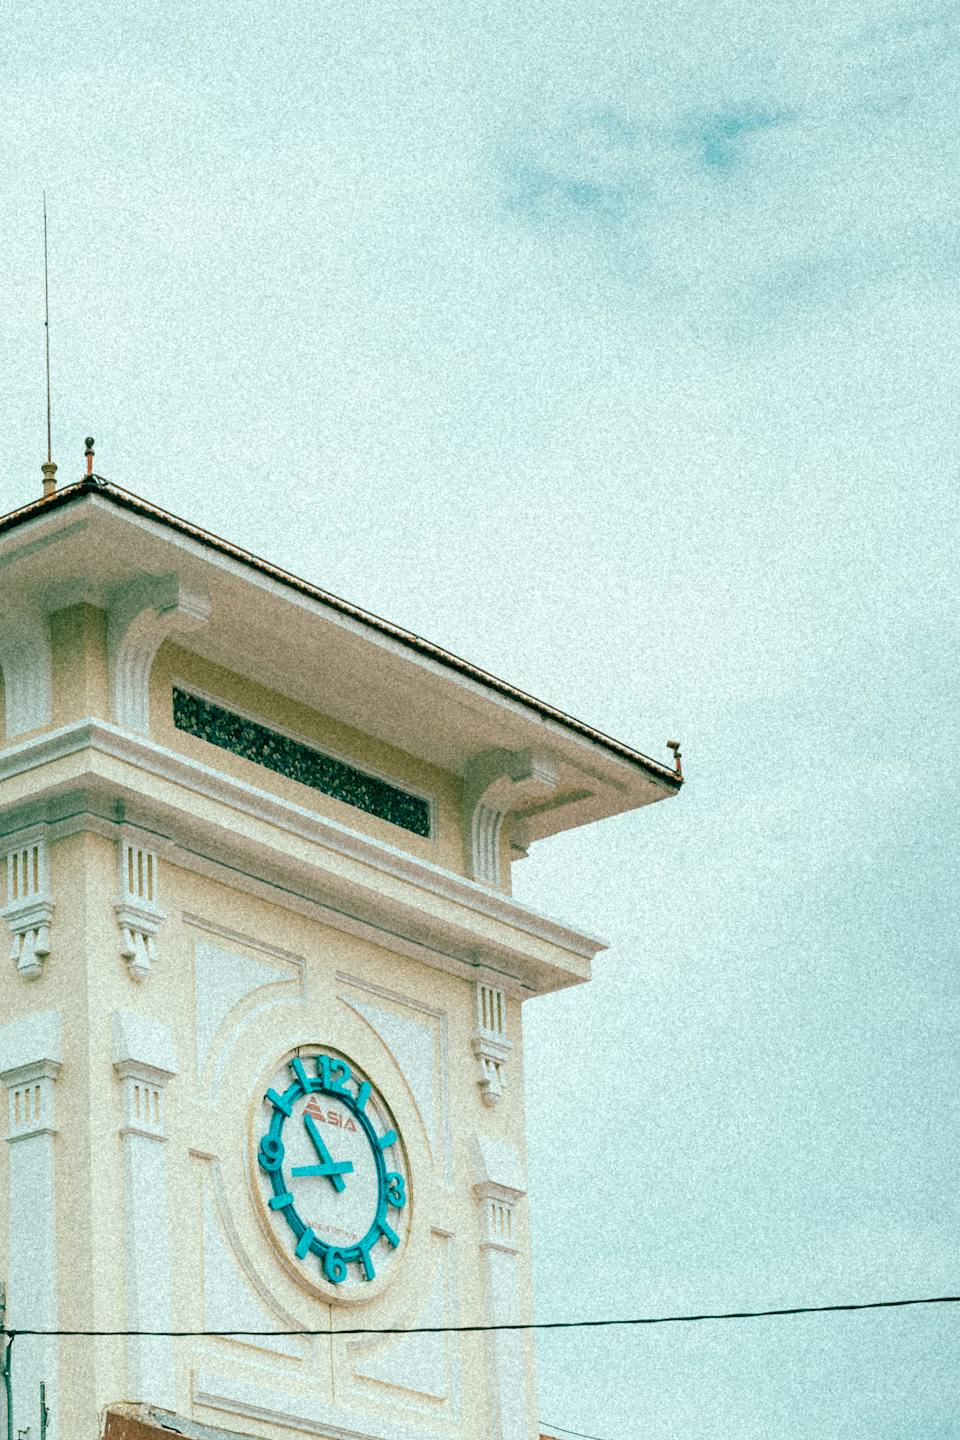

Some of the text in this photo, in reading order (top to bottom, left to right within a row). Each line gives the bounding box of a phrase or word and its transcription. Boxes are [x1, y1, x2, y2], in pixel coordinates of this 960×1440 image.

[317, 1055, 354, 1097] 12
[258, 1134, 285, 1171] 9
[386, 1171, 408, 1208] 3
[324, 1248, 348, 1284] 6
